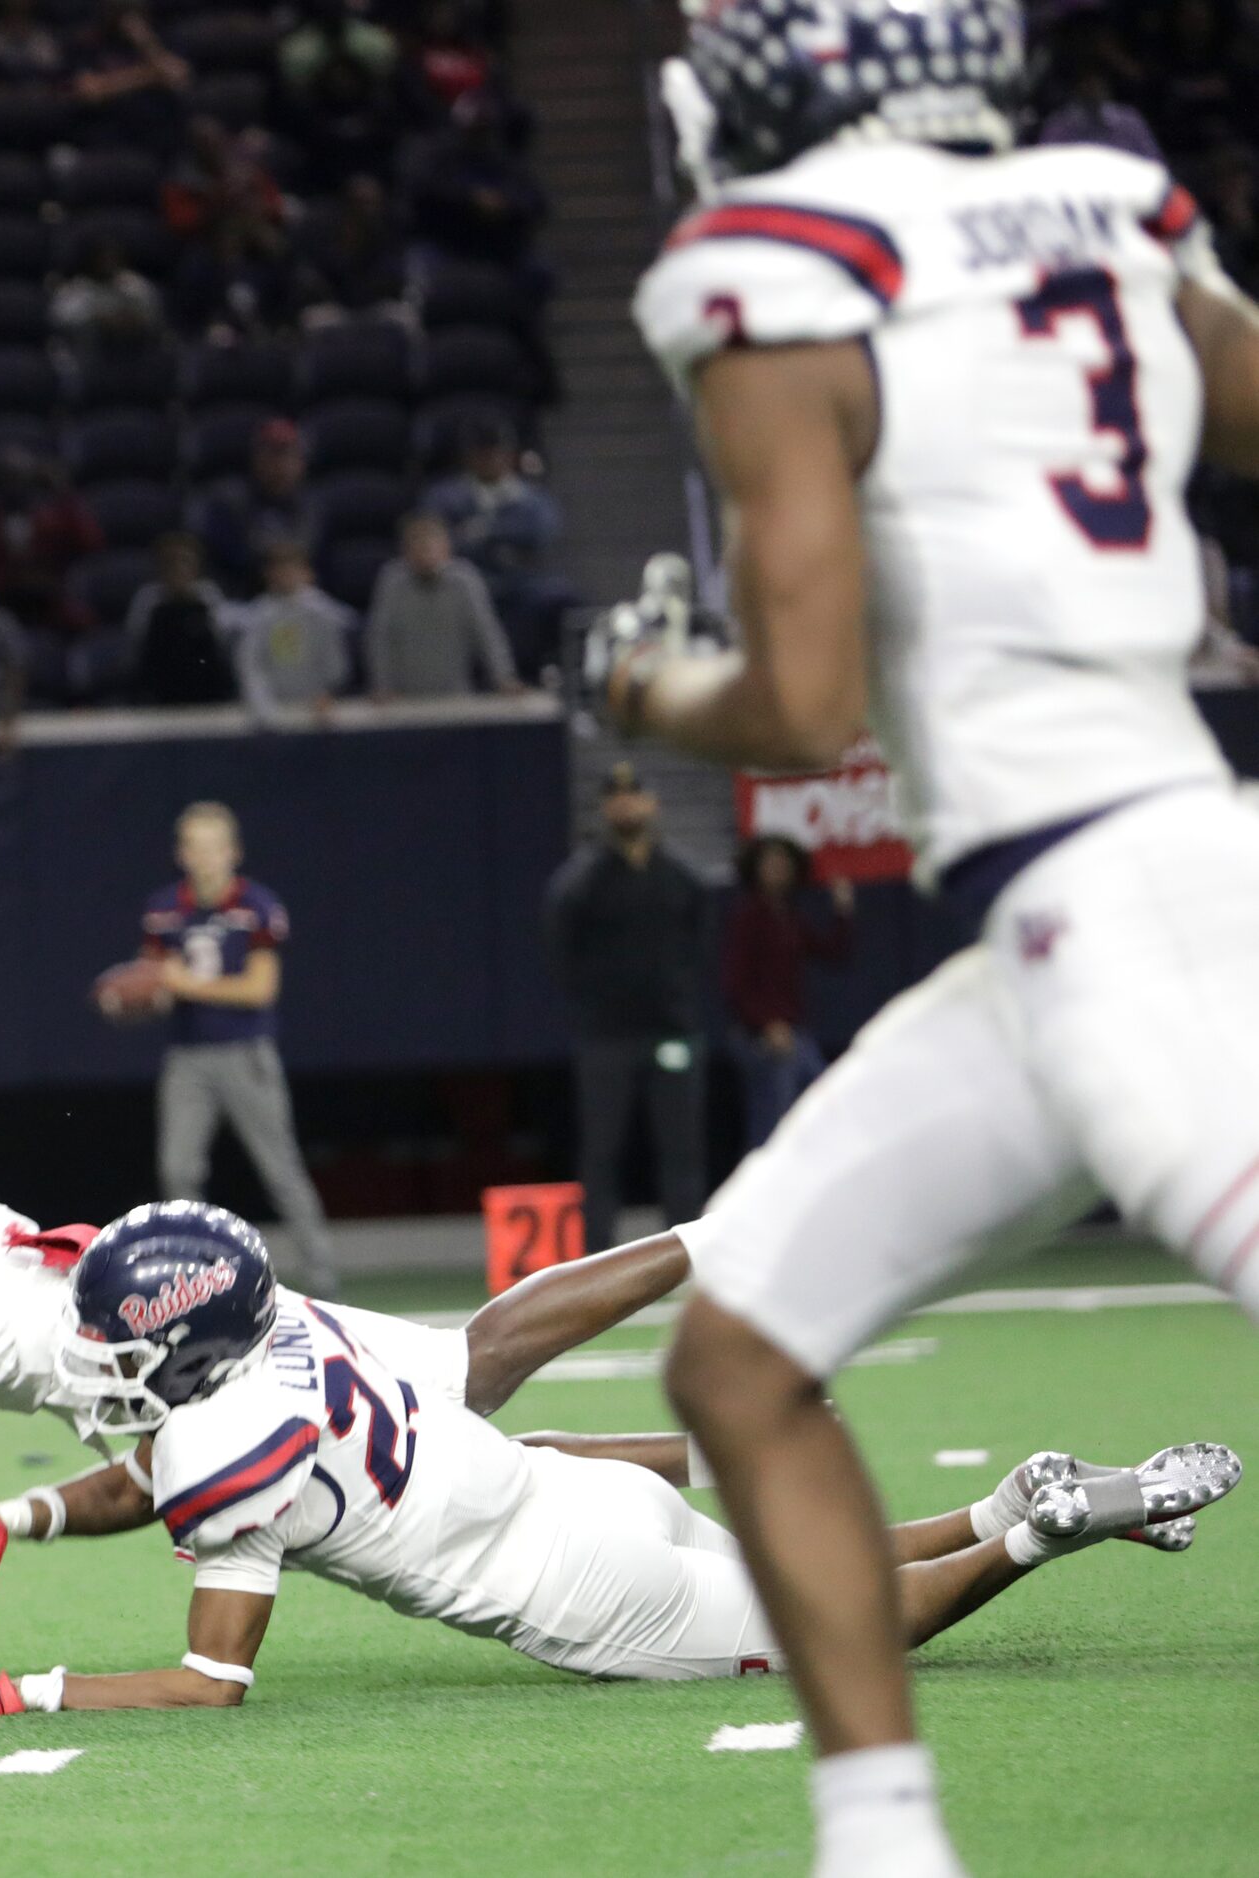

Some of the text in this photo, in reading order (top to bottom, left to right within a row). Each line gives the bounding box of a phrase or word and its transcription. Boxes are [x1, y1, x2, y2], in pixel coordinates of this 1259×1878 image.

[1010, 260, 1154, 552] 3
[506, 1202, 584, 1279] 20
[117, 1256, 239, 1339] Raiders
